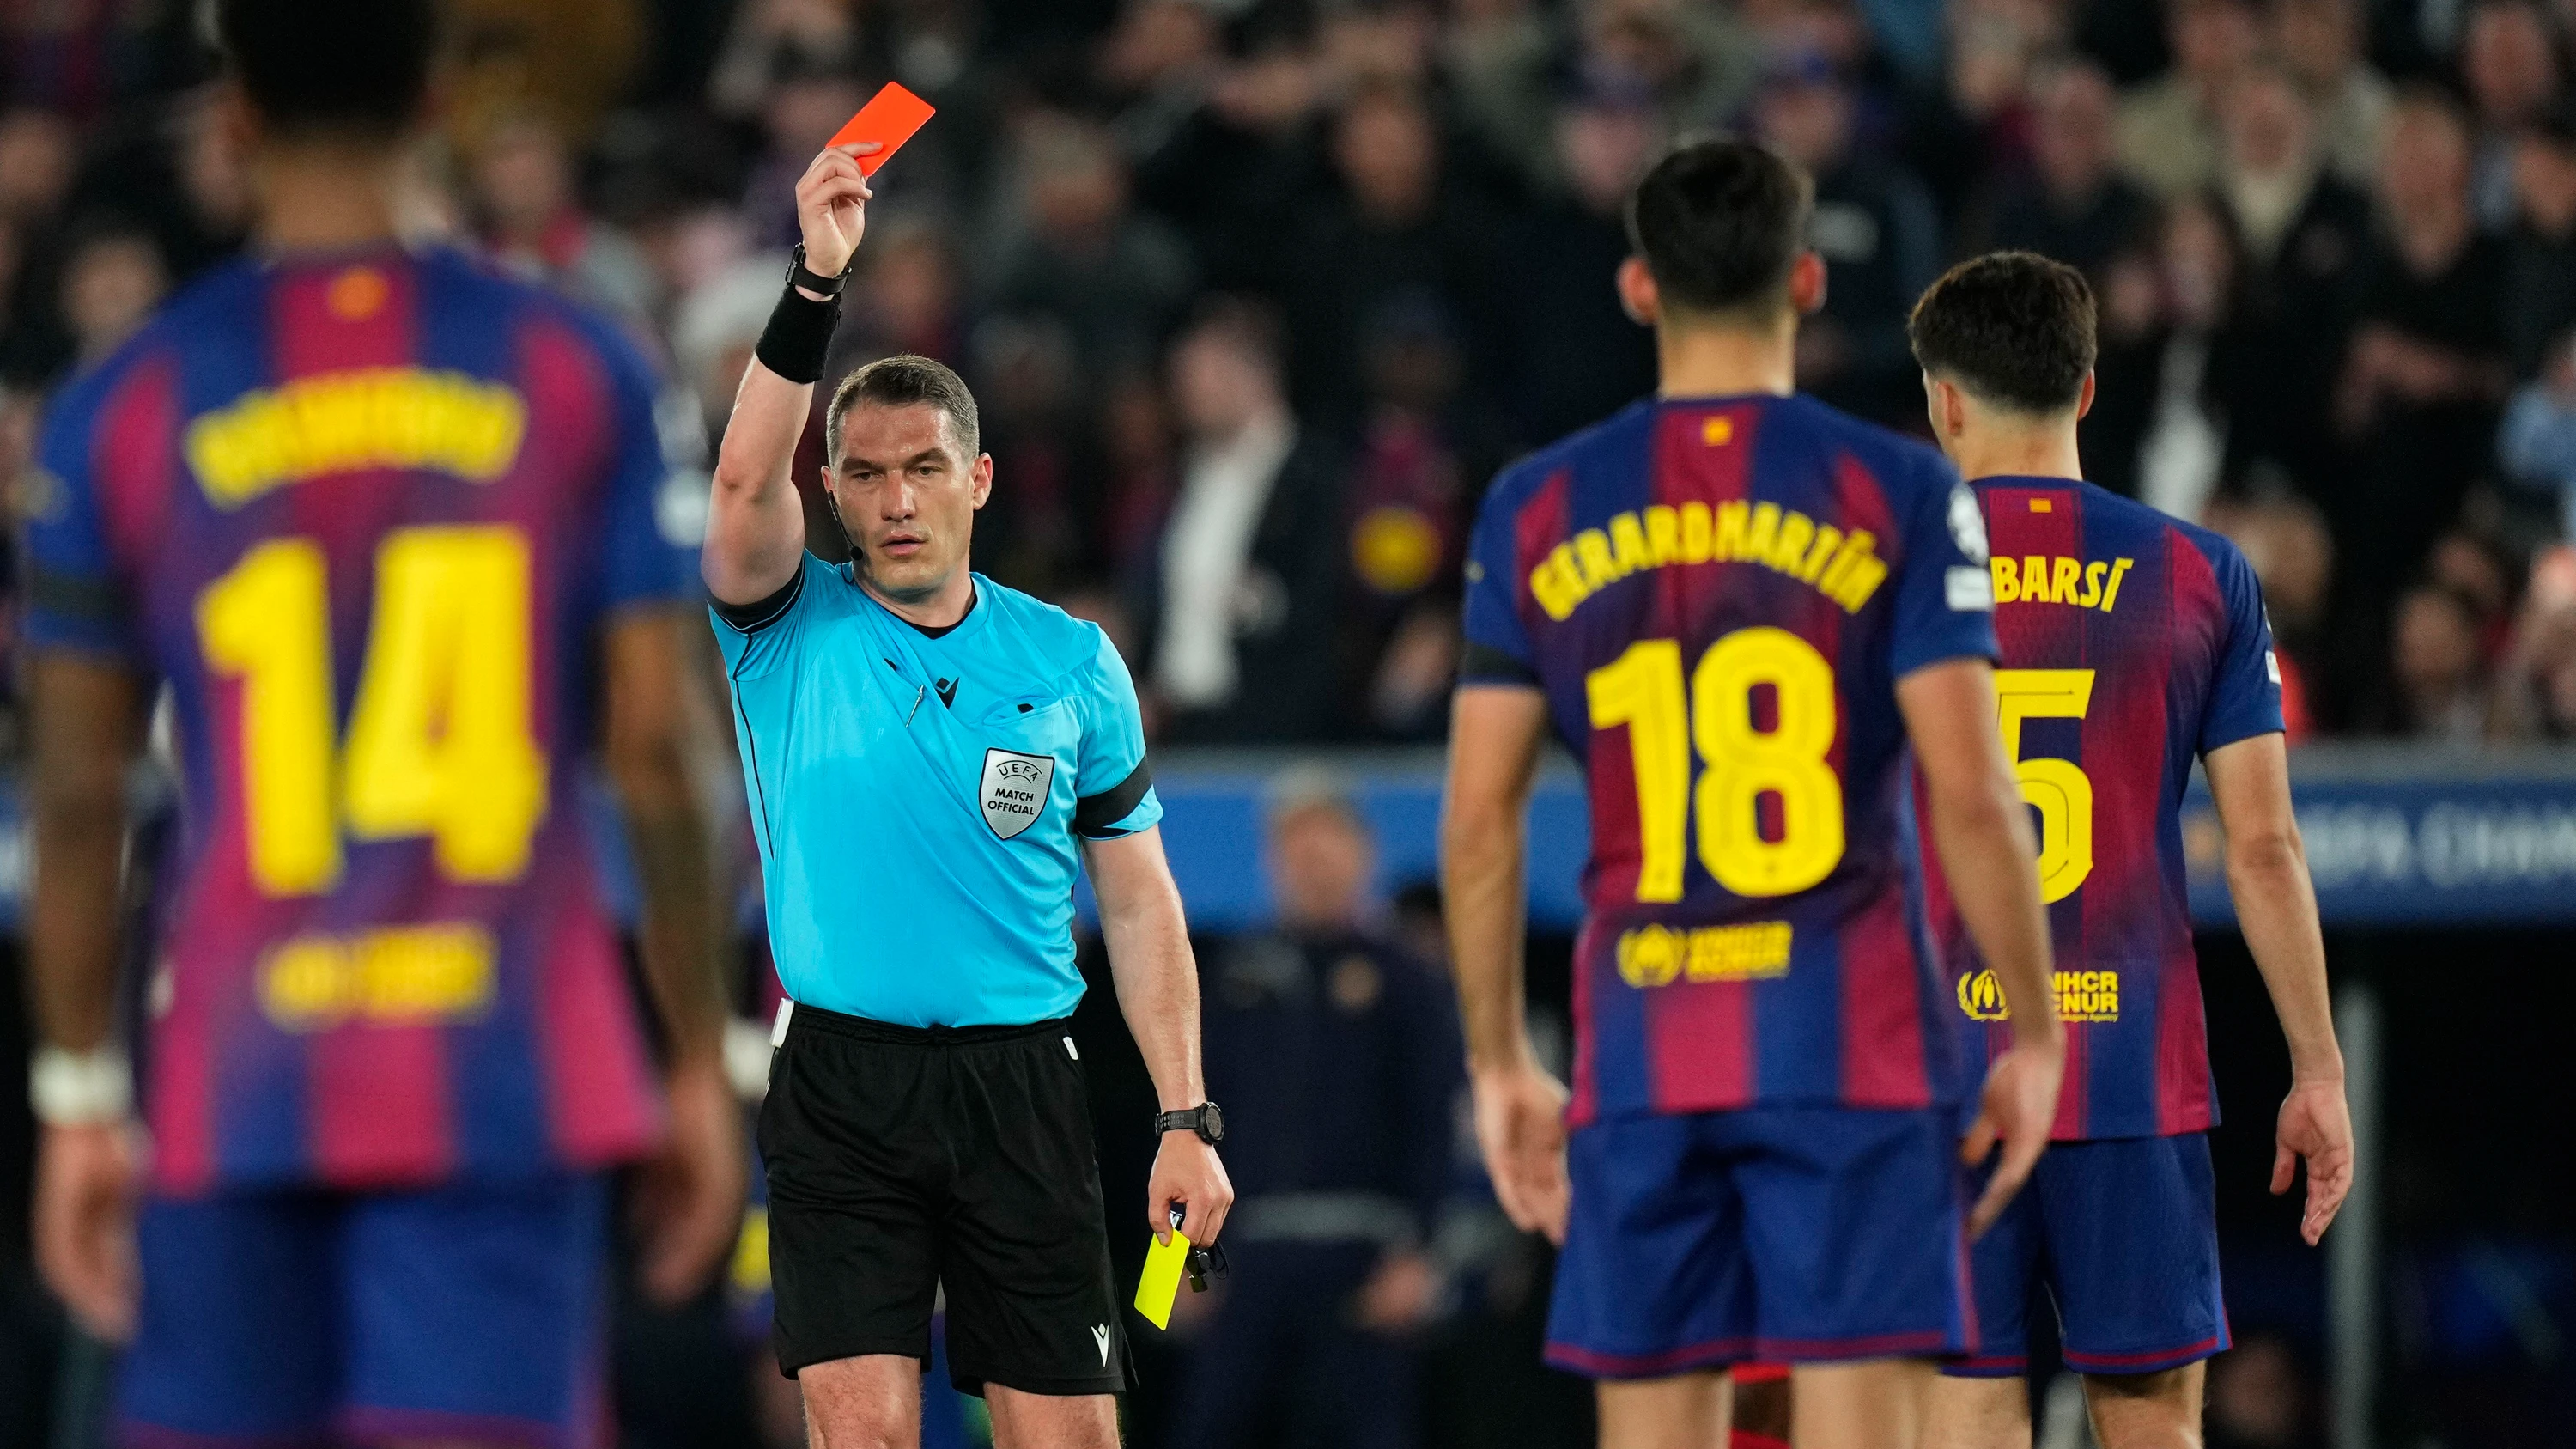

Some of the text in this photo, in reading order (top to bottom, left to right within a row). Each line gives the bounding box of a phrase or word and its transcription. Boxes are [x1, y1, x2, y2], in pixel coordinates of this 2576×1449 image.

[1990, 556, 2133, 612] BARSÍ
[200, 527, 544, 893] 14
[999, 763, 1037, 781] UEFA
[1587, 627, 1845, 902] 18
[995, 788, 1034, 801] MATCH
[1991, 669, 2095, 904] 5
[987, 800, 1034, 815] OFFICIAL
[2049, 971, 2118, 992] NHCR
